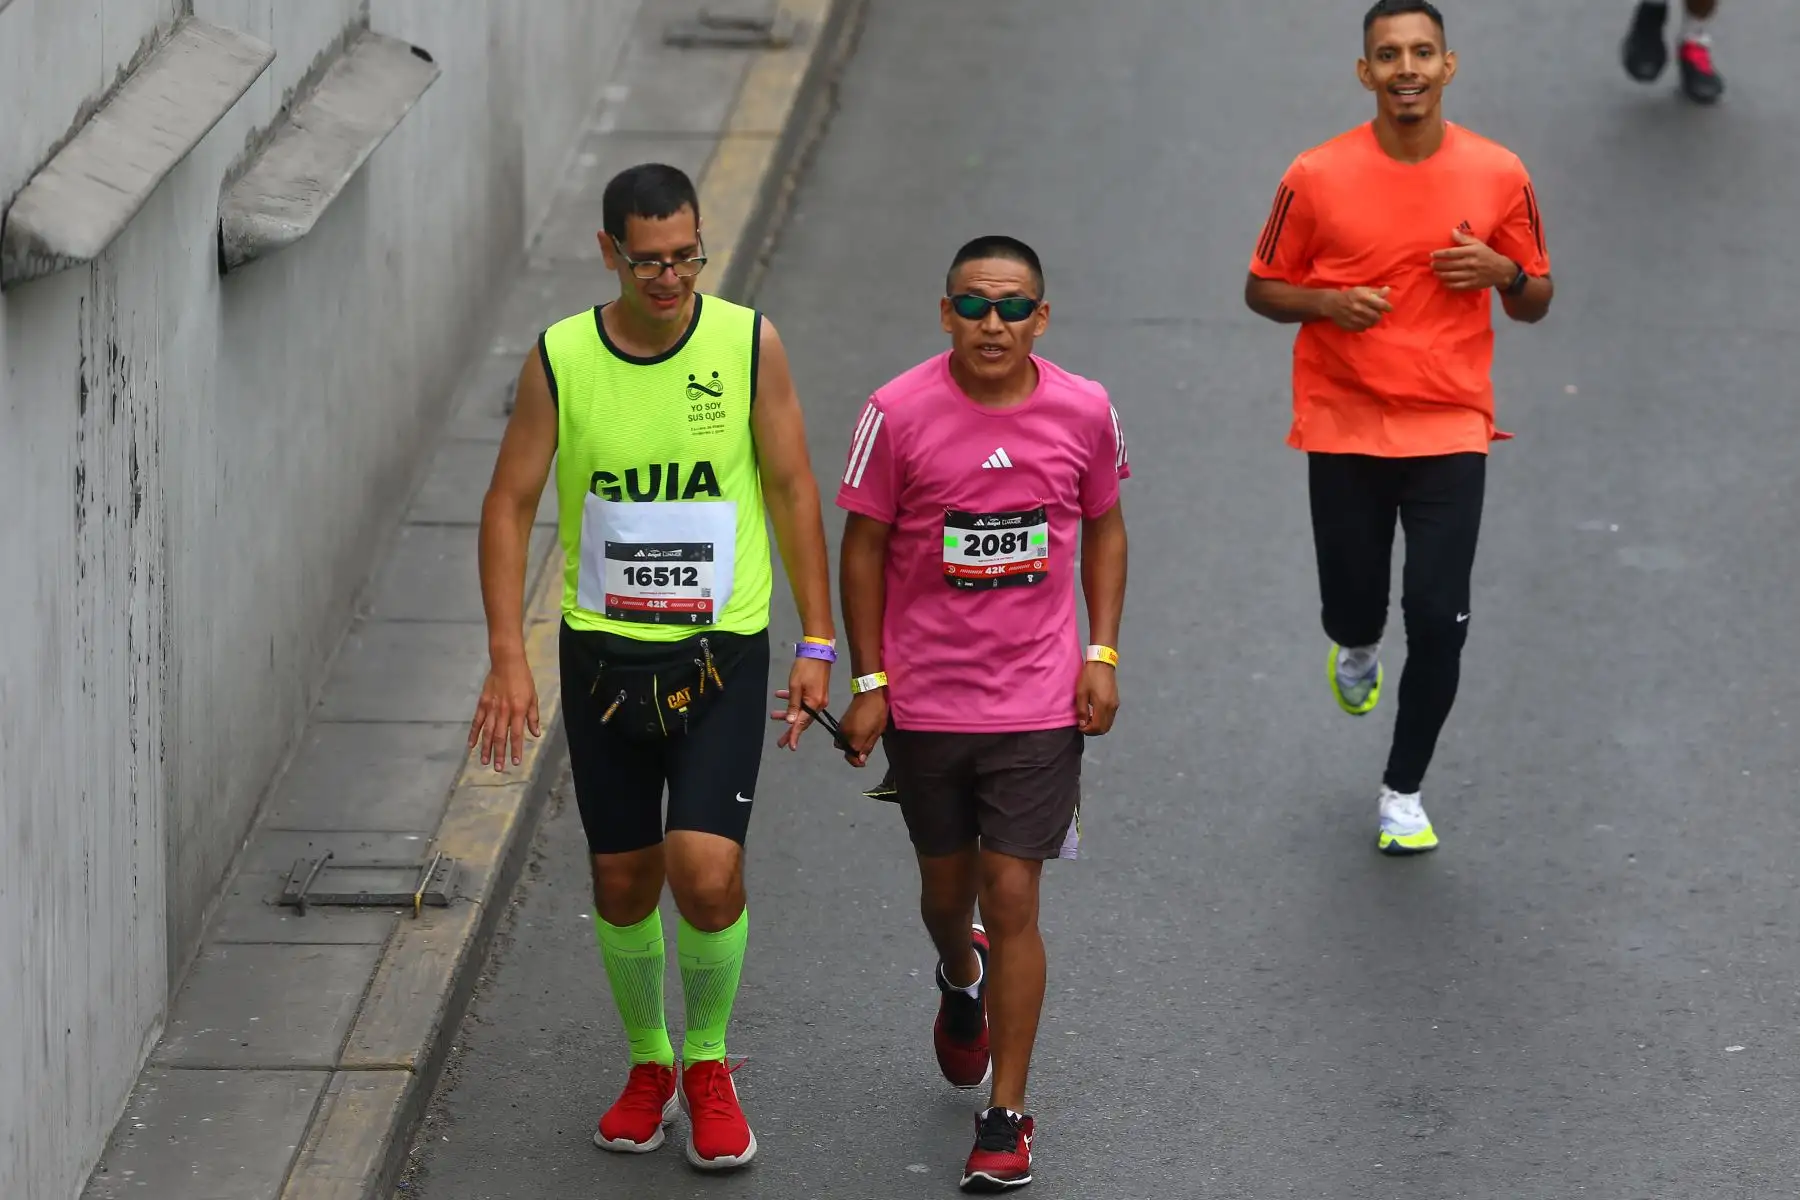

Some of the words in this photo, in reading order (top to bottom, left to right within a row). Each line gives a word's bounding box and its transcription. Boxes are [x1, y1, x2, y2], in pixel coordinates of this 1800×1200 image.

[691, 404, 703, 412] YO
[704, 402, 721, 411] SOY
[688, 413, 704, 422] SUS
[705, 411, 726, 421] OJOS
[590, 461, 722, 502] GUIA
[964, 531, 1028, 557] 2081
[623, 566, 698, 587] 16512
[985, 566, 1006, 575] 42K
[646, 600, 668, 609] 42K
[667, 687, 691, 709] CAT
